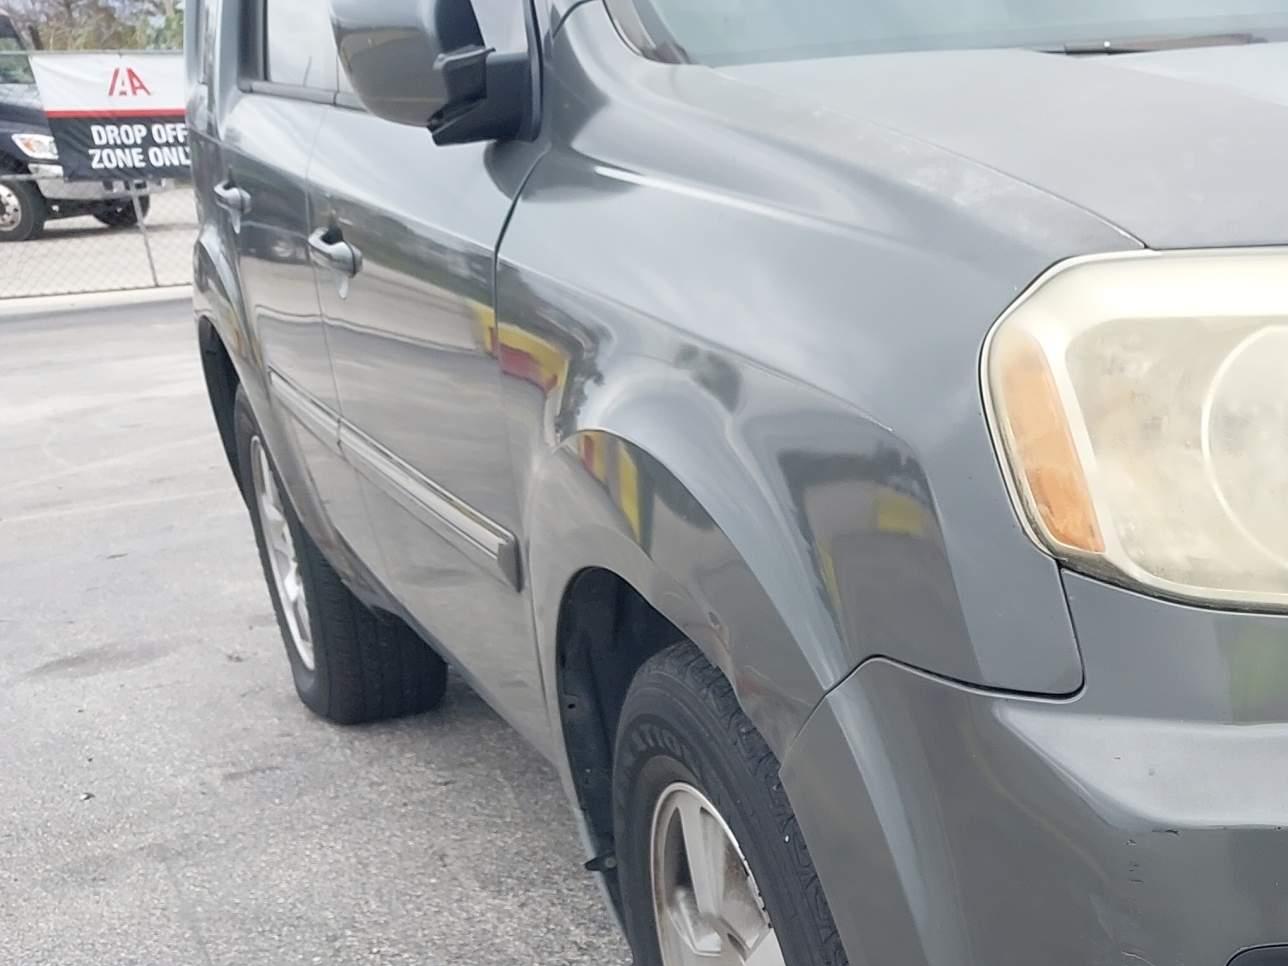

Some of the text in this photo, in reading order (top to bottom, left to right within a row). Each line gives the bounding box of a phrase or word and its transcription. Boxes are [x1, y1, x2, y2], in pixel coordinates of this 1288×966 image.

[90, 123, 188, 145] DROP OFF
[88, 147, 146, 168] ZONE
